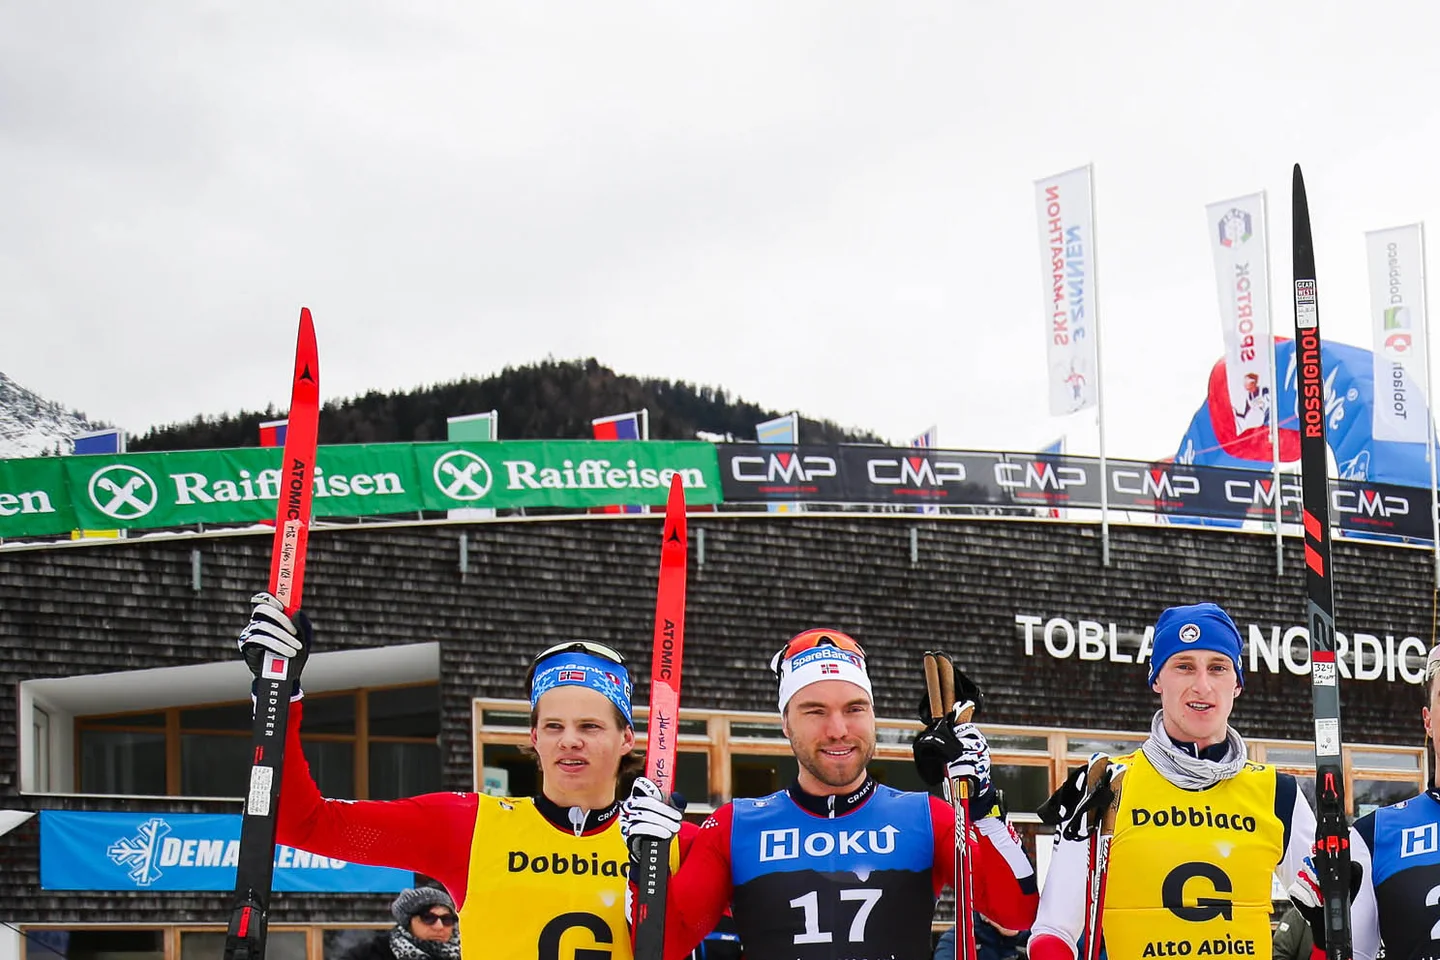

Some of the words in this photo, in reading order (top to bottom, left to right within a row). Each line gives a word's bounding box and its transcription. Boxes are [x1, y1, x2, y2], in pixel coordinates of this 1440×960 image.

[503, 459, 707, 490] Raiffeisen
[732, 453, 836, 483] CMP
[867, 457, 966, 487] CMP
[994, 462, 1087, 490] CMP
[170, 466, 405, 505] Raiffisen
[288, 458, 305, 521] ATOMIC
[1112, 470, 1200, 498] CMP
[1332, 490, 1410, 517] CMP
[660, 618, 674, 680] ATOMIC
[1016, 614, 1155, 664] TOBLA
[1131, 805, 1257, 833] Dobbiaco
[759, 825, 901, 863] HOKU
[508, 852, 630, 877] Dobbiac
[1161, 861, 1234, 923] G
[789, 888, 883, 945] 17
